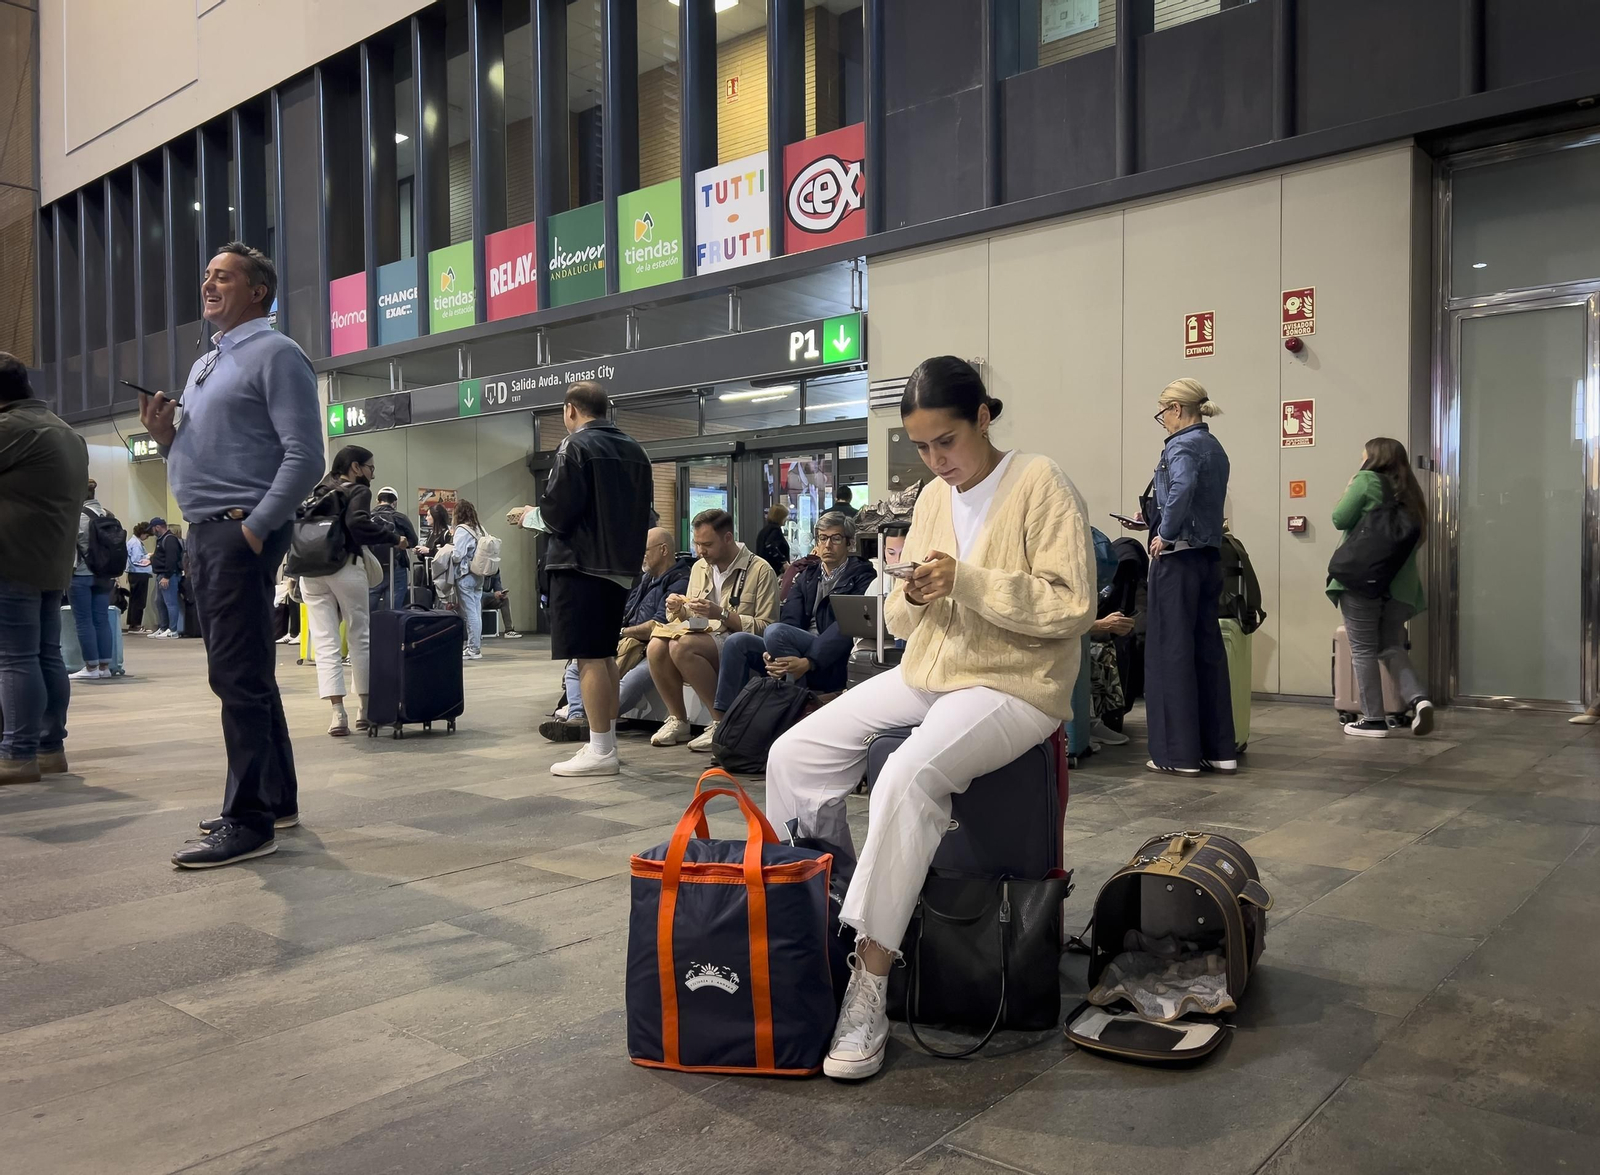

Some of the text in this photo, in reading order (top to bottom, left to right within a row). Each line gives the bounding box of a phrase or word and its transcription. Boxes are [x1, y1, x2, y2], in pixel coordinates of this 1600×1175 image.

[701, 169, 765, 208] TUTTI
[549, 236, 606, 270] discover
[624, 238, 679, 265] tiendas
[489, 252, 533, 298] RELAY
[550, 261, 598, 281] ANDALUCÍA
[635, 256, 679, 274] de la estación
[433, 290, 474, 311] tiendas
[441, 310, 449, 319] de
[1283, 321, 1314, 331] AVISADOR
[1285, 327, 1311, 336] SONORO
[789, 329, 820, 362] P1
[1186, 345, 1213, 356] EXTINTOR
[511, 377, 536, 392] Salida
[538, 374, 562, 388] Avda.
[564, 369, 595, 384] Kansas
[597, 364, 615, 380] City
[511, 395, 522, 403] EXIT
